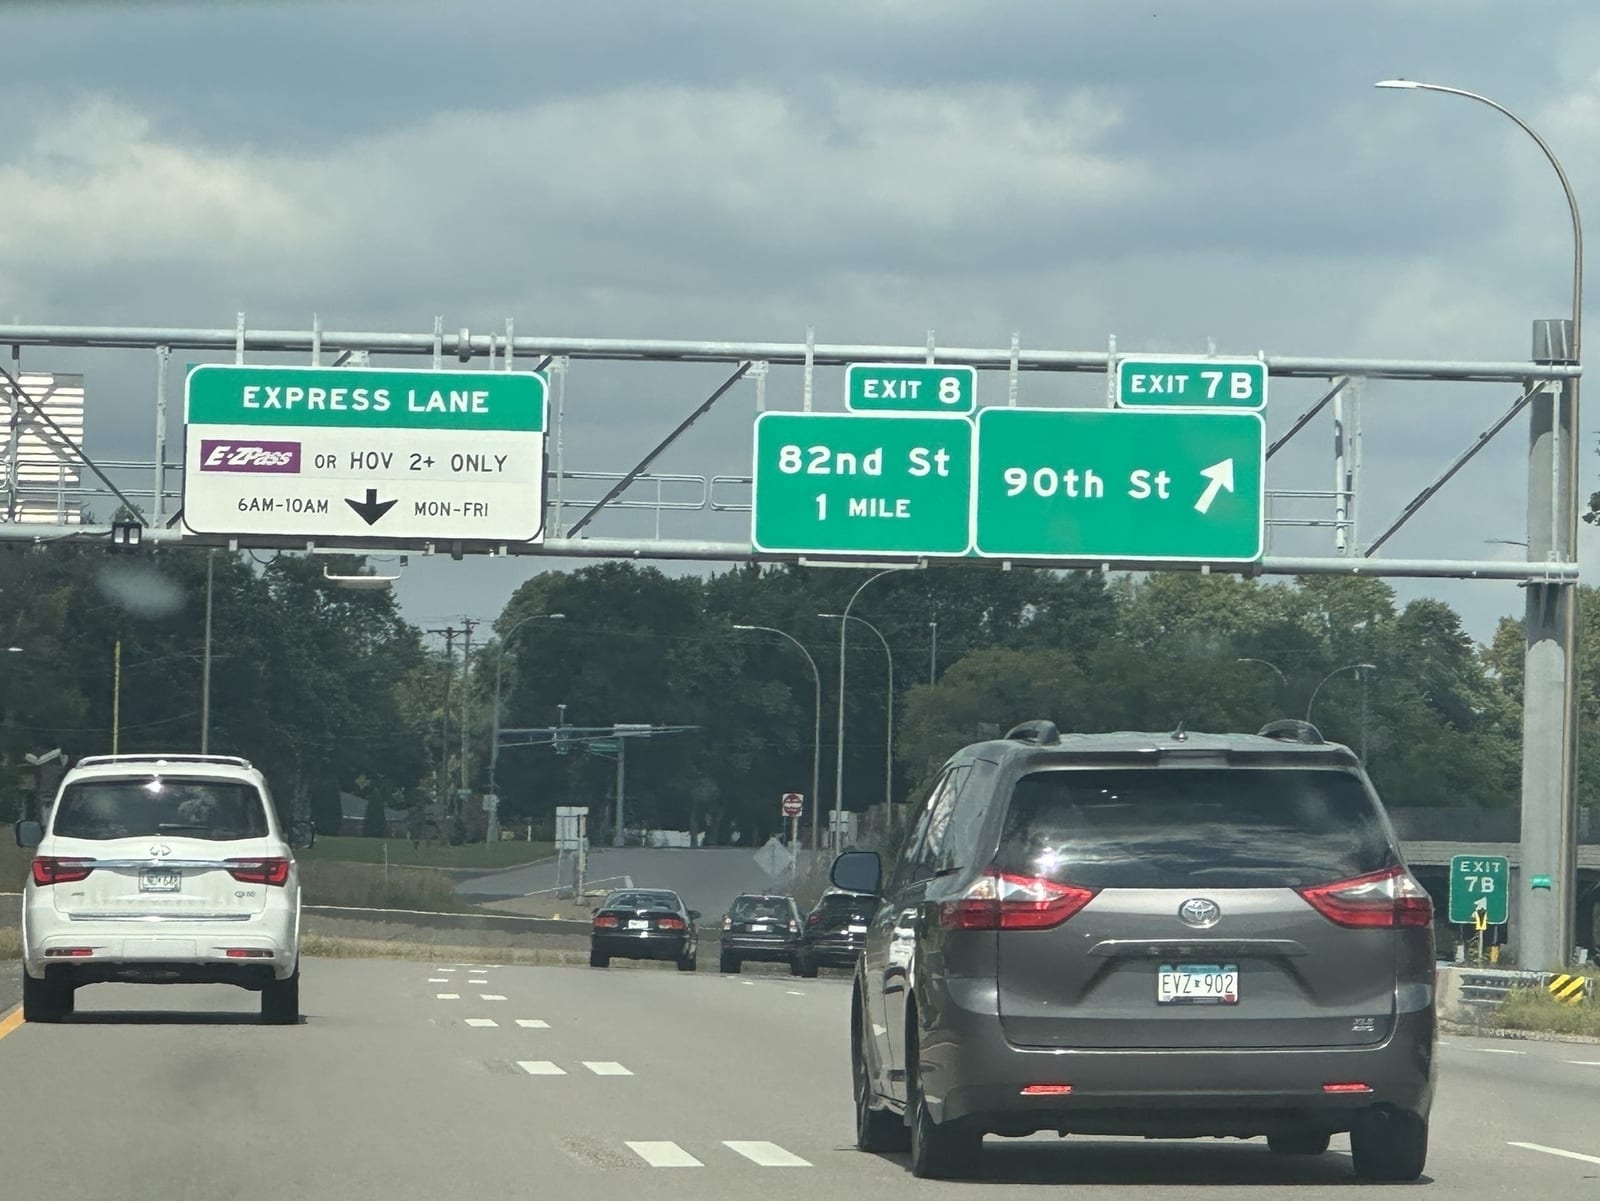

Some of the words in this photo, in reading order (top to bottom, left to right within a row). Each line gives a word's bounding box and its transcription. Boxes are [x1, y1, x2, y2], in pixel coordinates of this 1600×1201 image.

[863, 379, 922, 399] EXIT
[938, 376, 961, 404] 8
[1131, 374, 1189, 393] EXIT
[1200, 371, 1253, 399] 7B
[243, 386, 391, 411] EXPRESS
[408, 389, 489, 413] LANE
[314, 454, 337, 469] OR
[350, 451, 393, 470] HOV
[409, 453, 435, 471] 2+
[451, 453, 508, 472] ONLY
[778, 445, 883, 476] 82nd
[908, 447, 950, 477] St
[1004, 467, 1104, 497] 90th
[1128, 469, 1171, 500] St
[237, 498, 329, 513] 6AM-10AM
[414, 501, 489, 517] MON-FRI
[815, 493, 827, 521] 1
[848, 498, 911, 518] MILE
[1460, 861, 1501, 873] EXIT
[1464, 876, 1495, 893] 7B
